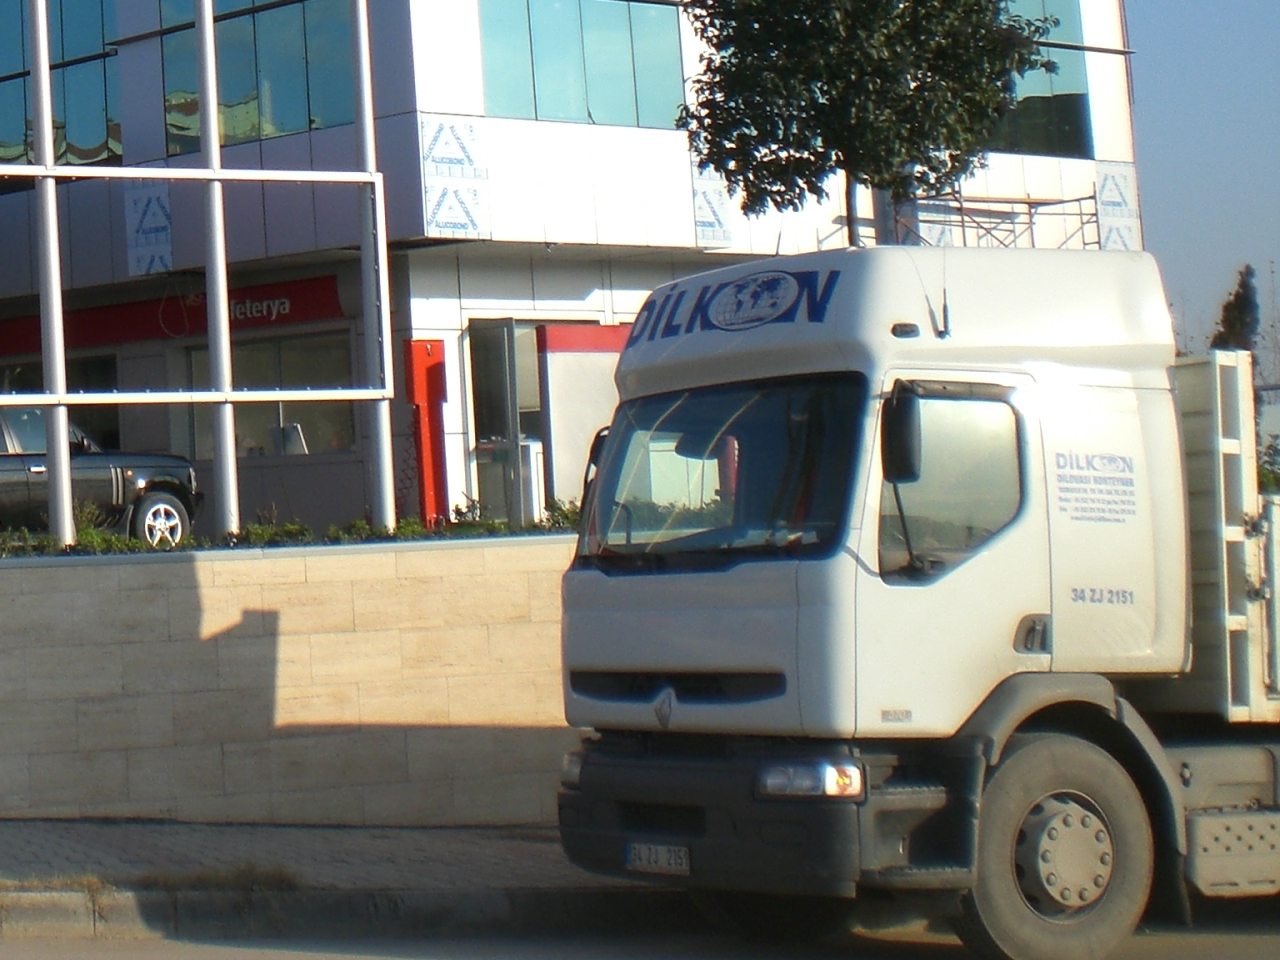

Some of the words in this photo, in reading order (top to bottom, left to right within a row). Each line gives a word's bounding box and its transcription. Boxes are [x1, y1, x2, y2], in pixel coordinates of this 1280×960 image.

[229, 298, 291, 321] feterya
[1071, 587, 1086, 603] 34
[1107, 588, 1134, 605] 2151
